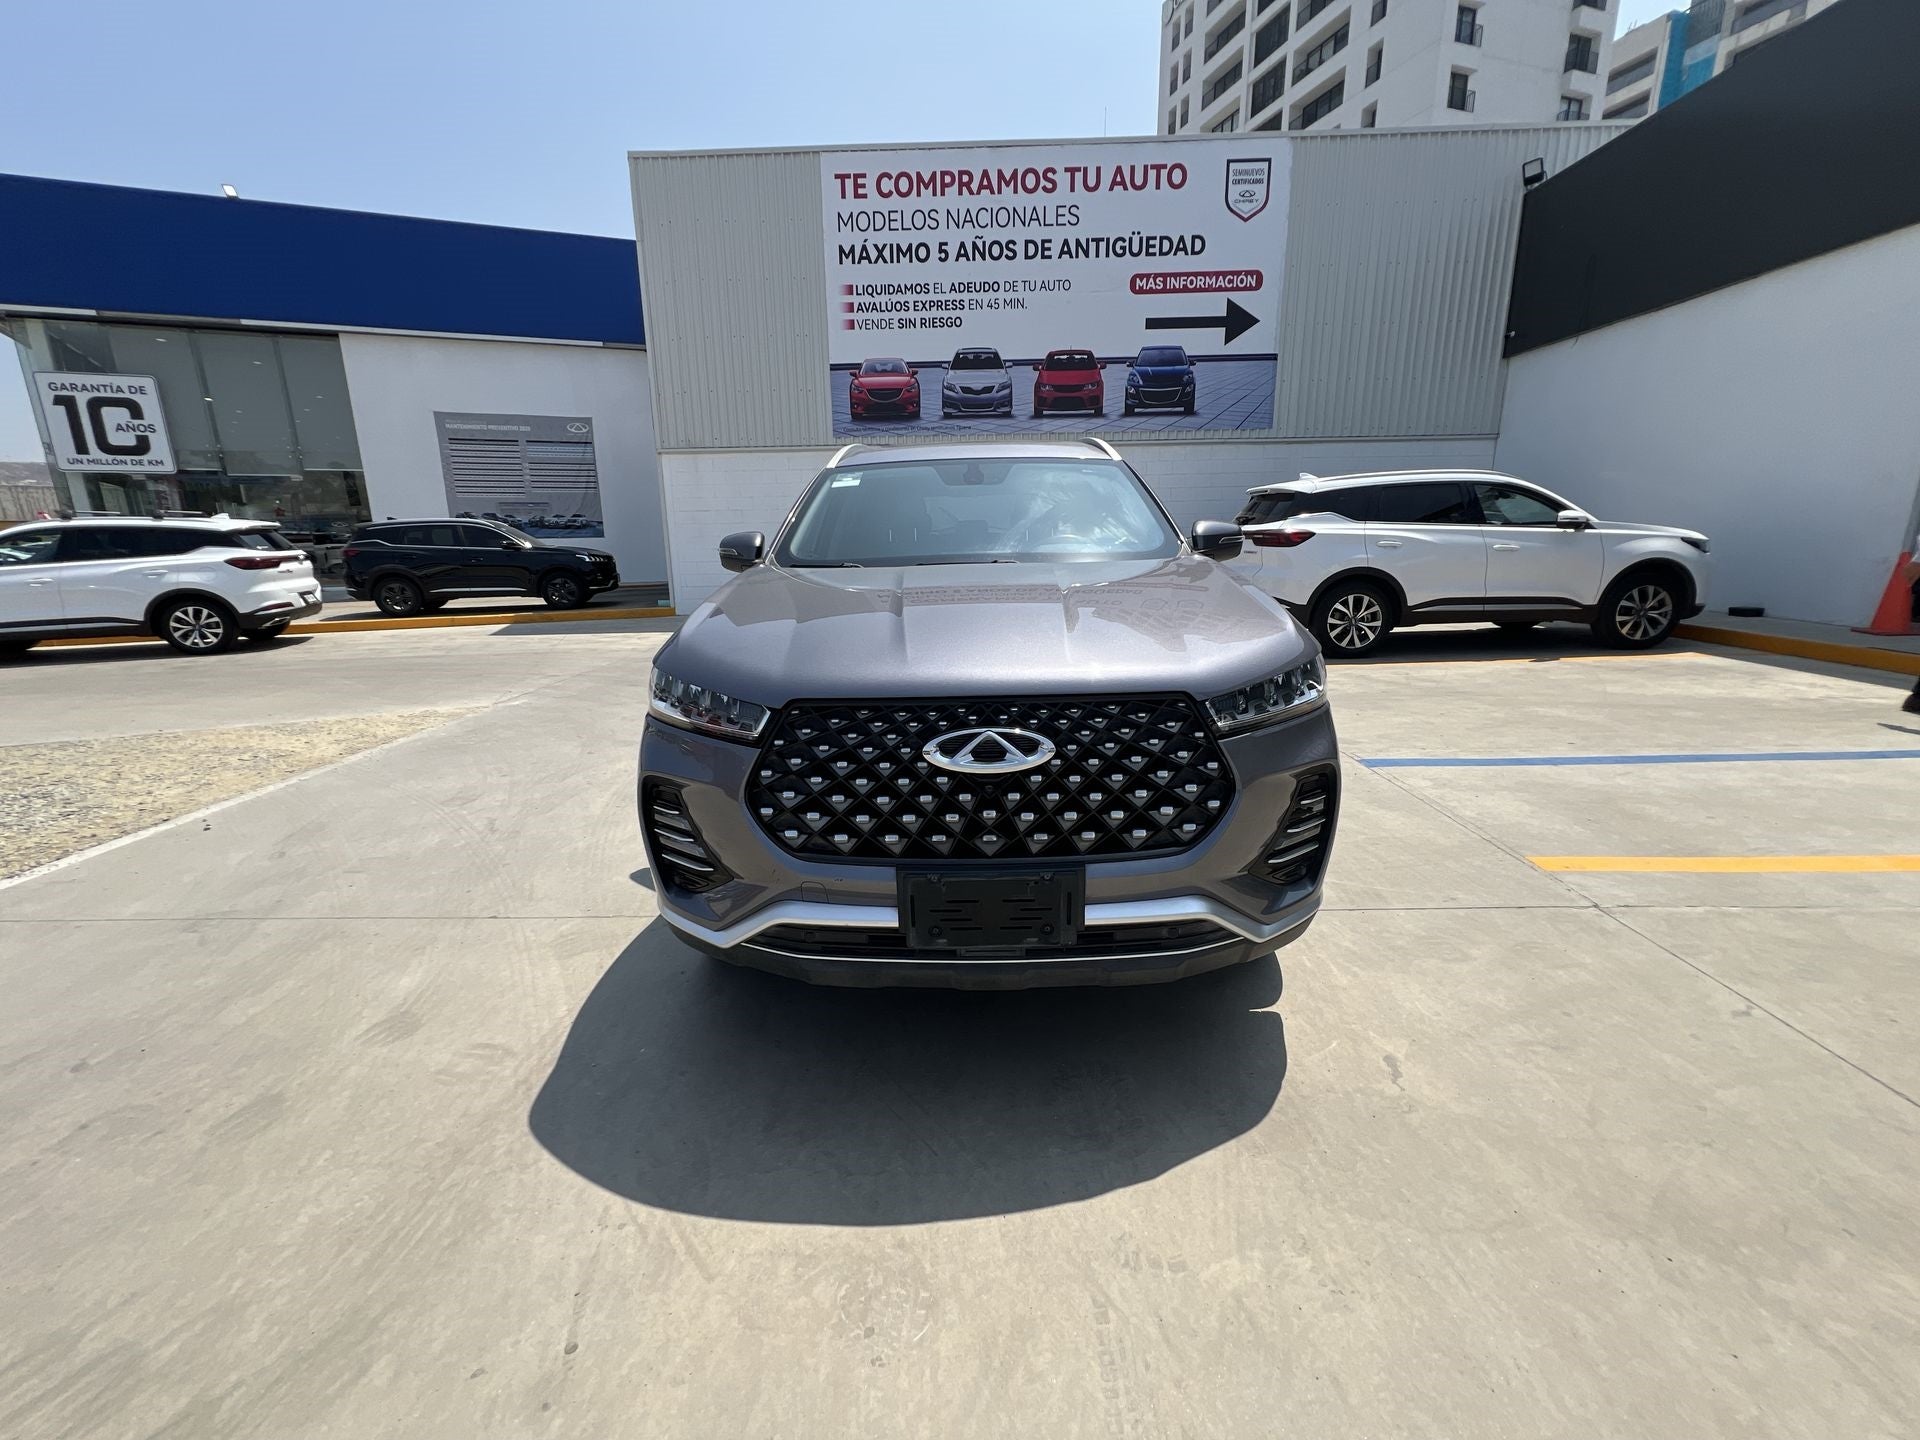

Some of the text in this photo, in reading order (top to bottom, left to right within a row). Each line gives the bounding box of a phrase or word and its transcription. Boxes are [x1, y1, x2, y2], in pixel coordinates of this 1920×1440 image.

[834, 163, 1188, 199] TE COMPRAMOS TU AUTO
[1232, 168, 1265, 177] SEMINUEVOS
[837, 205, 1080, 233] MODELOS NACIONALES
[838, 230, 1206, 265] MÁXIMO 5 AÑOS DE ANTIGÜEDAD
[855, 279, 1071, 297] LIQUIDAMOS EL ADEUDO DE TU AUTO
[1136, 272, 1256, 290] MÁS INFORMACIÓN
[856, 297, 1028, 313] AVALÚOS EXPRESS EN 45 MIN.
[856, 316, 963, 330] VENDE SIN RIESGO
[48, 382, 147, 395] GARANTÍA DE
[53, 395, 151, 456] 10
[116, 421, 156, 434] AÑOS
[87, 457, 128, 466] MILLÓN
